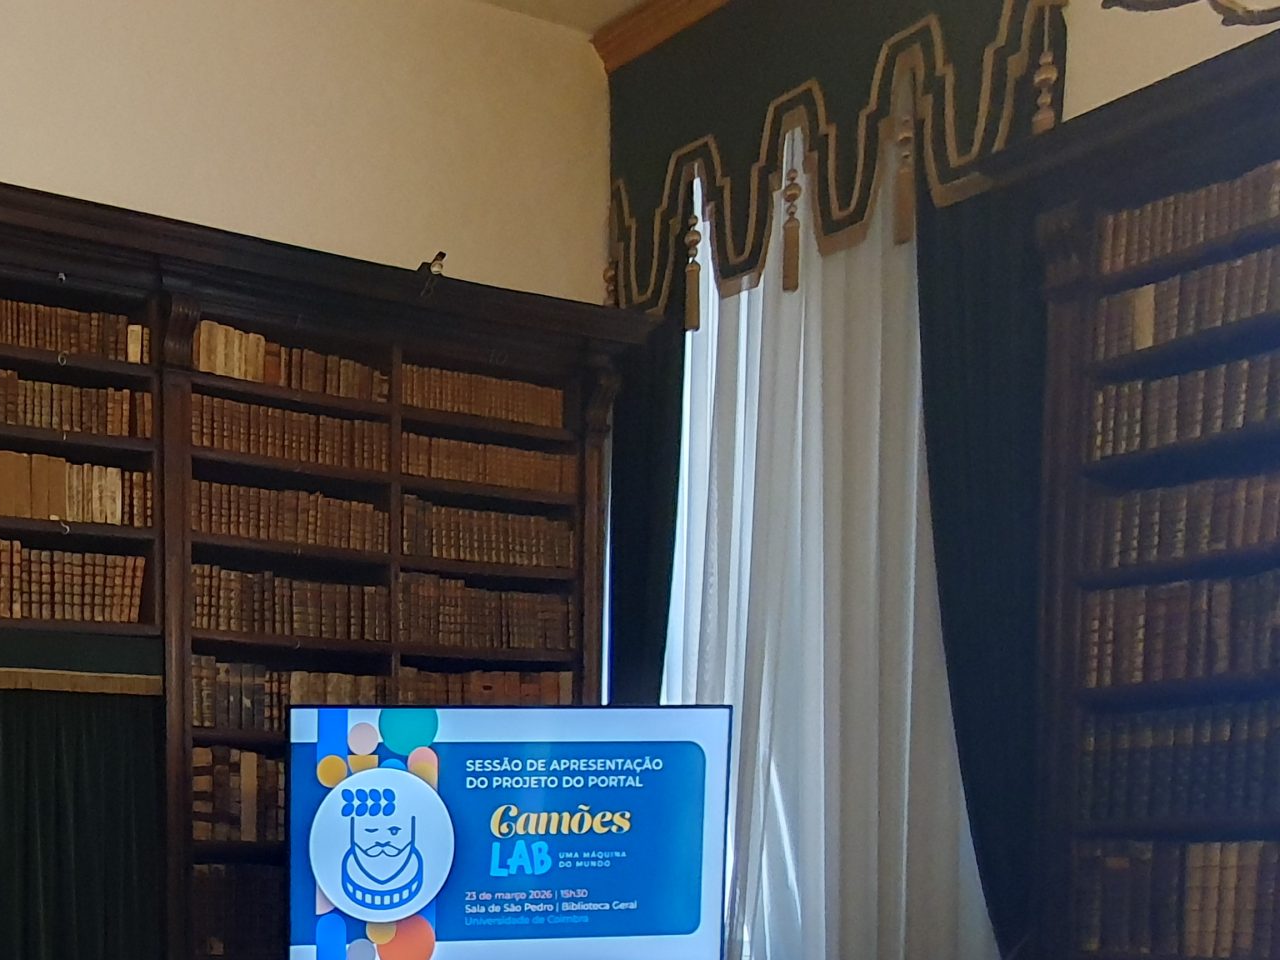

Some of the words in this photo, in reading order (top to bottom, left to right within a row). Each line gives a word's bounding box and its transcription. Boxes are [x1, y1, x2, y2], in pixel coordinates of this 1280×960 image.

[465, 757, 522, 772] SESSÃO
[526, 759, 546, 771] DE
[549, 756, 663, 773] APRESENTAÇÃO
[465, 777, 489, 789] DO
[492, 776, 559, 789] PROJETO
[562, 776, 584, 788] DO
[588, 775, 643, 788] PORTAL
[490, 804, 631, 839] Camões
[489, 840, 552, 877] LAB
[558, 851, 579, 859] UMA
[558, 860, 572, 868] DO
[575, 860, 611, 868] MUNDO
[465, 891, 476, 901] 23
[478, 891, 492, 901] de
[494, 891, 527, 902] março
[528, 890, 553, 900] 2026
[560, 889, 588, 899] 15h30
[465, 904, 485, 914] Sala
[487, 904, 501, 913] de
[503, 903, 522, 913] São
[524, 903, 554, 912] Pedro
[561, 901, 610, 911] Biblioteca
[611, 900, 638, 910] Geral
[464, 915, 530, 926] Universidade
[531, 915, 545, 925] de
[547, 914, 589, 925] Coimbra
